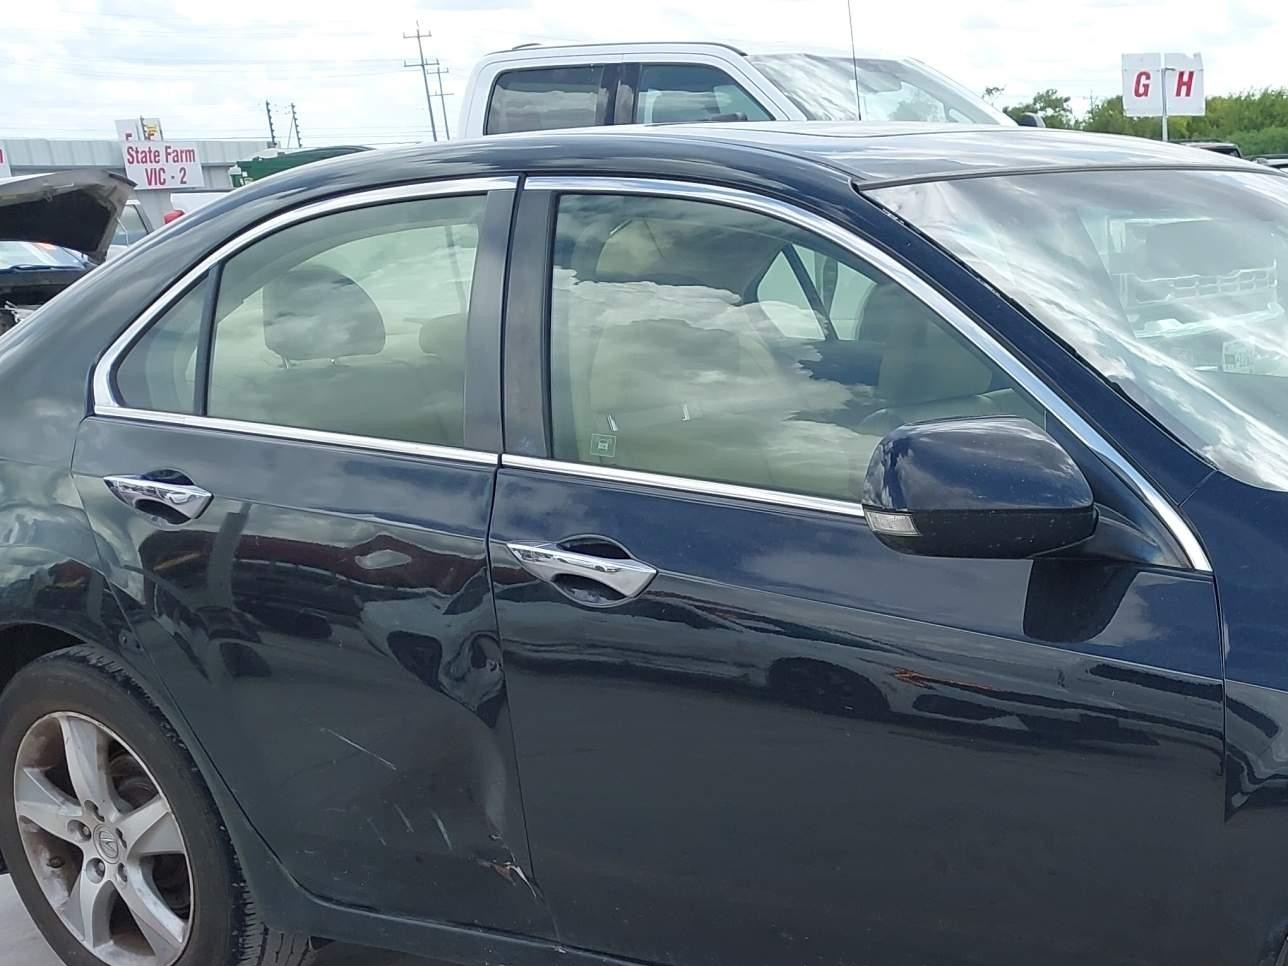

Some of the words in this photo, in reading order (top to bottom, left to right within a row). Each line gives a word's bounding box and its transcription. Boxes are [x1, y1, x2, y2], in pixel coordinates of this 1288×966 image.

[1133, 70, 1151, 98] G
[1175, 70, 1194, 97] H
[126, 145, 160, 165] State
[164, 144, 196, 164] Farm
[144, 167, 166, 186] VIC
[178, 166, 187, 185] 2
